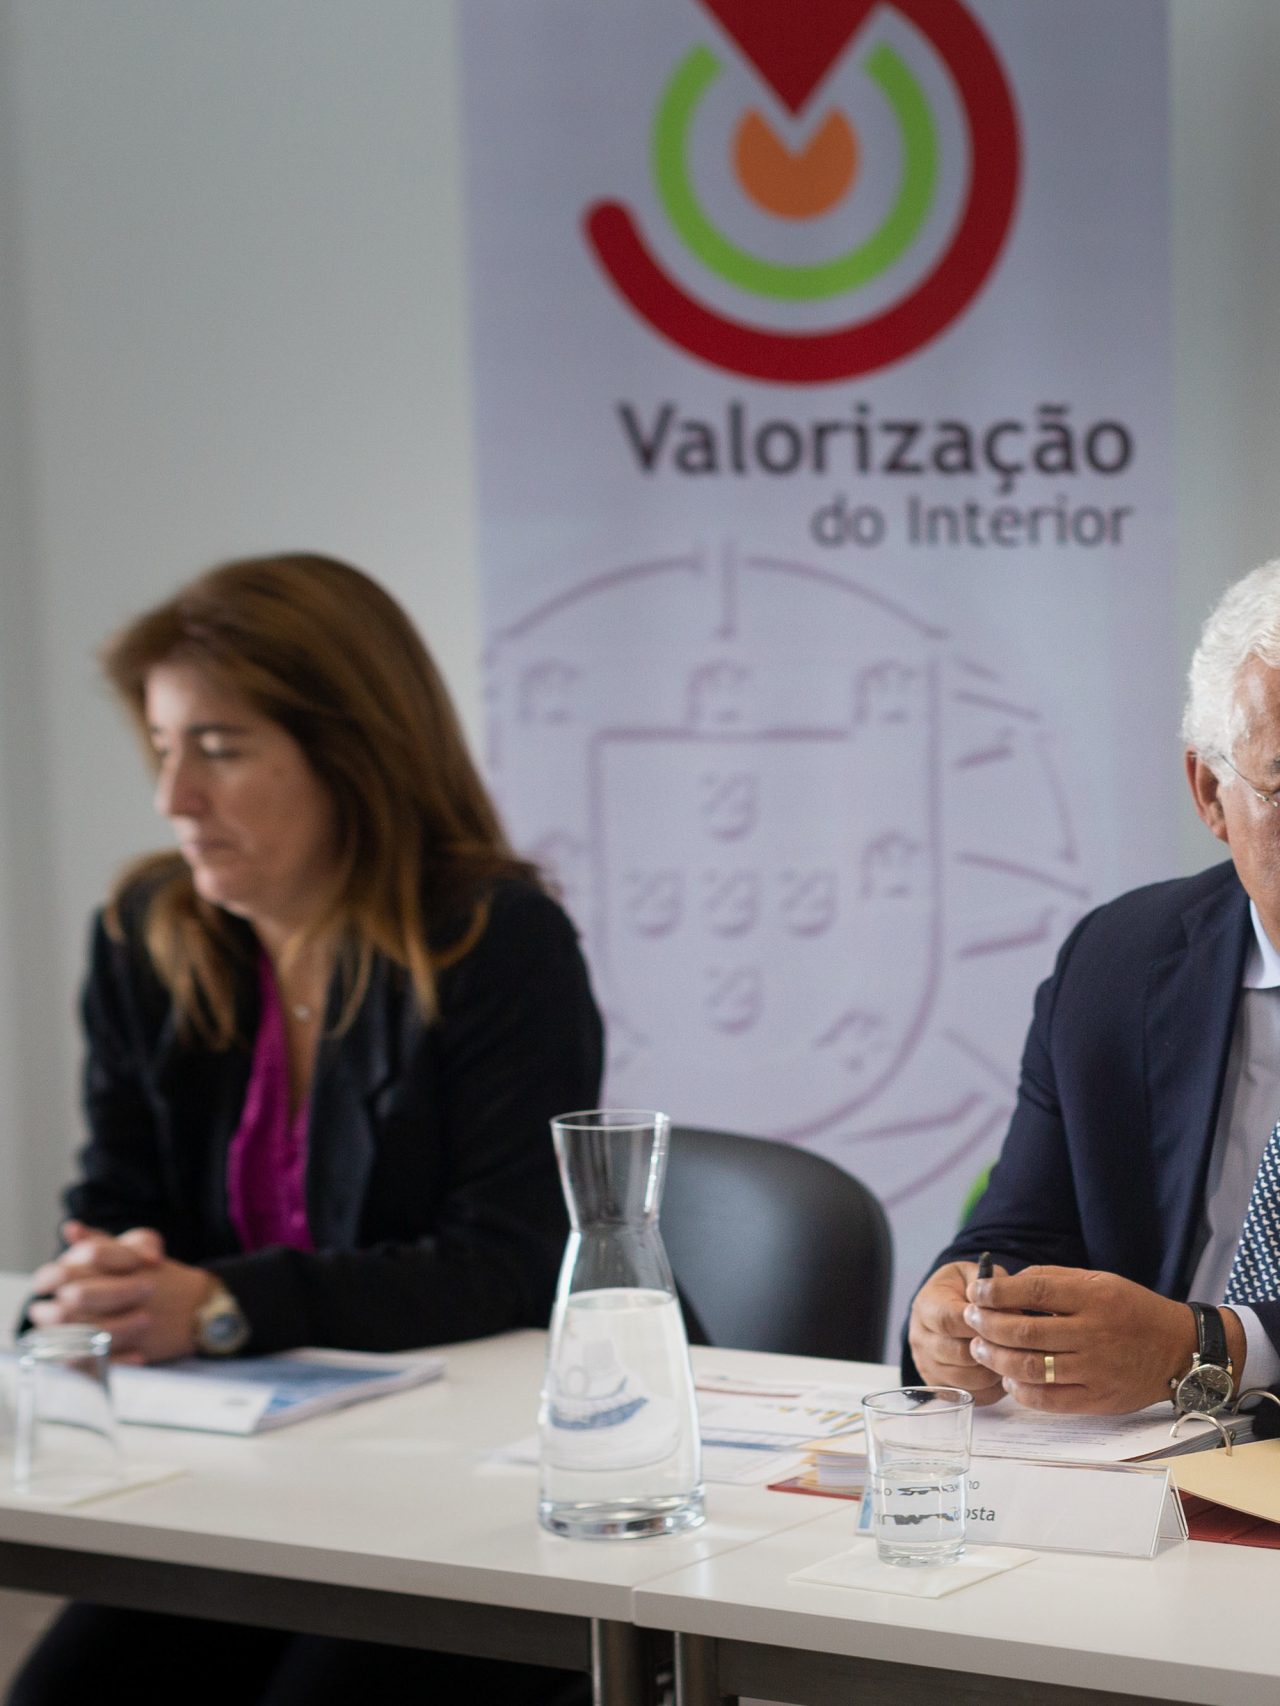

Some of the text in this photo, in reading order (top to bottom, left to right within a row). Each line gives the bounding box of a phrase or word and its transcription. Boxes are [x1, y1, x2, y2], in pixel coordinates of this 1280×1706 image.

[616, 402, 1134, 493] Valorização
[809, 494, 1132, 548] do Interior
[965, 1506, 996, 1522] osta
